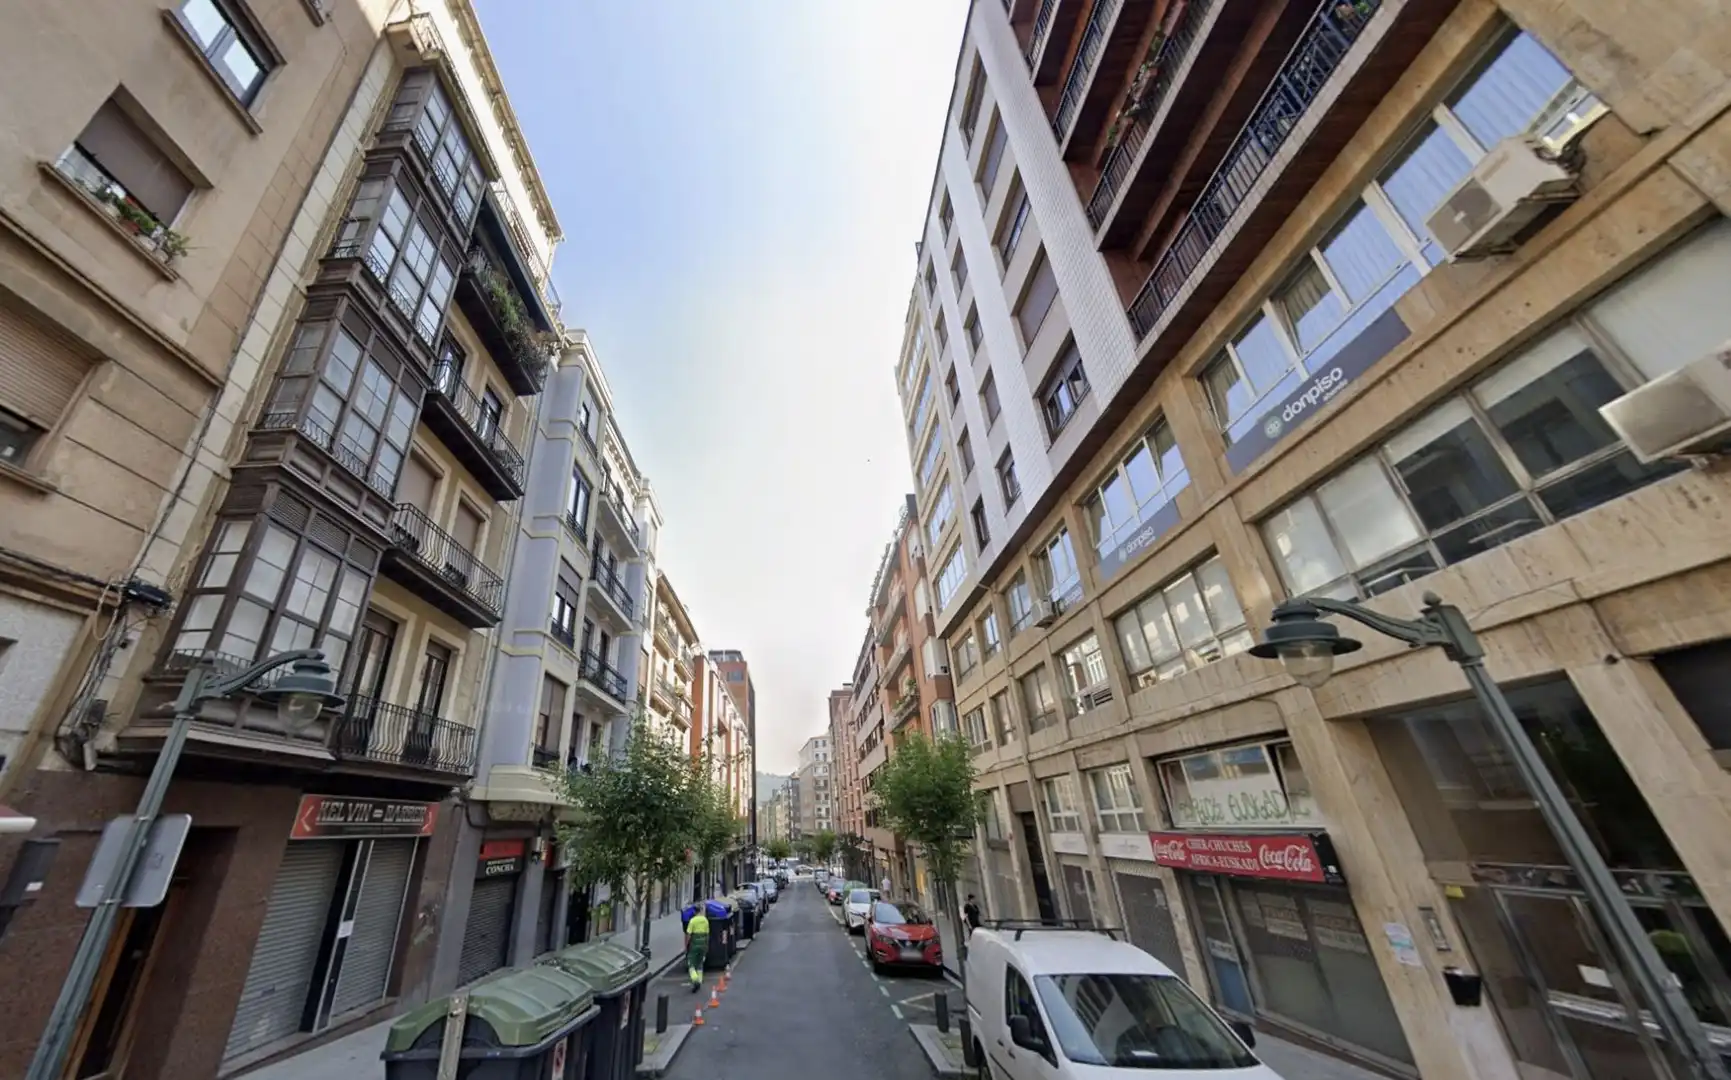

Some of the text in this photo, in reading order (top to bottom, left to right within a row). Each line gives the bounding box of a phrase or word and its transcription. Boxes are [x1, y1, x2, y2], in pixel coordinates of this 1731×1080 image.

[1282, 367, 1343, 422] donpiso
[315, 800, 372, 822] KELVIN
[383, 804, 428, 823] BARBER
